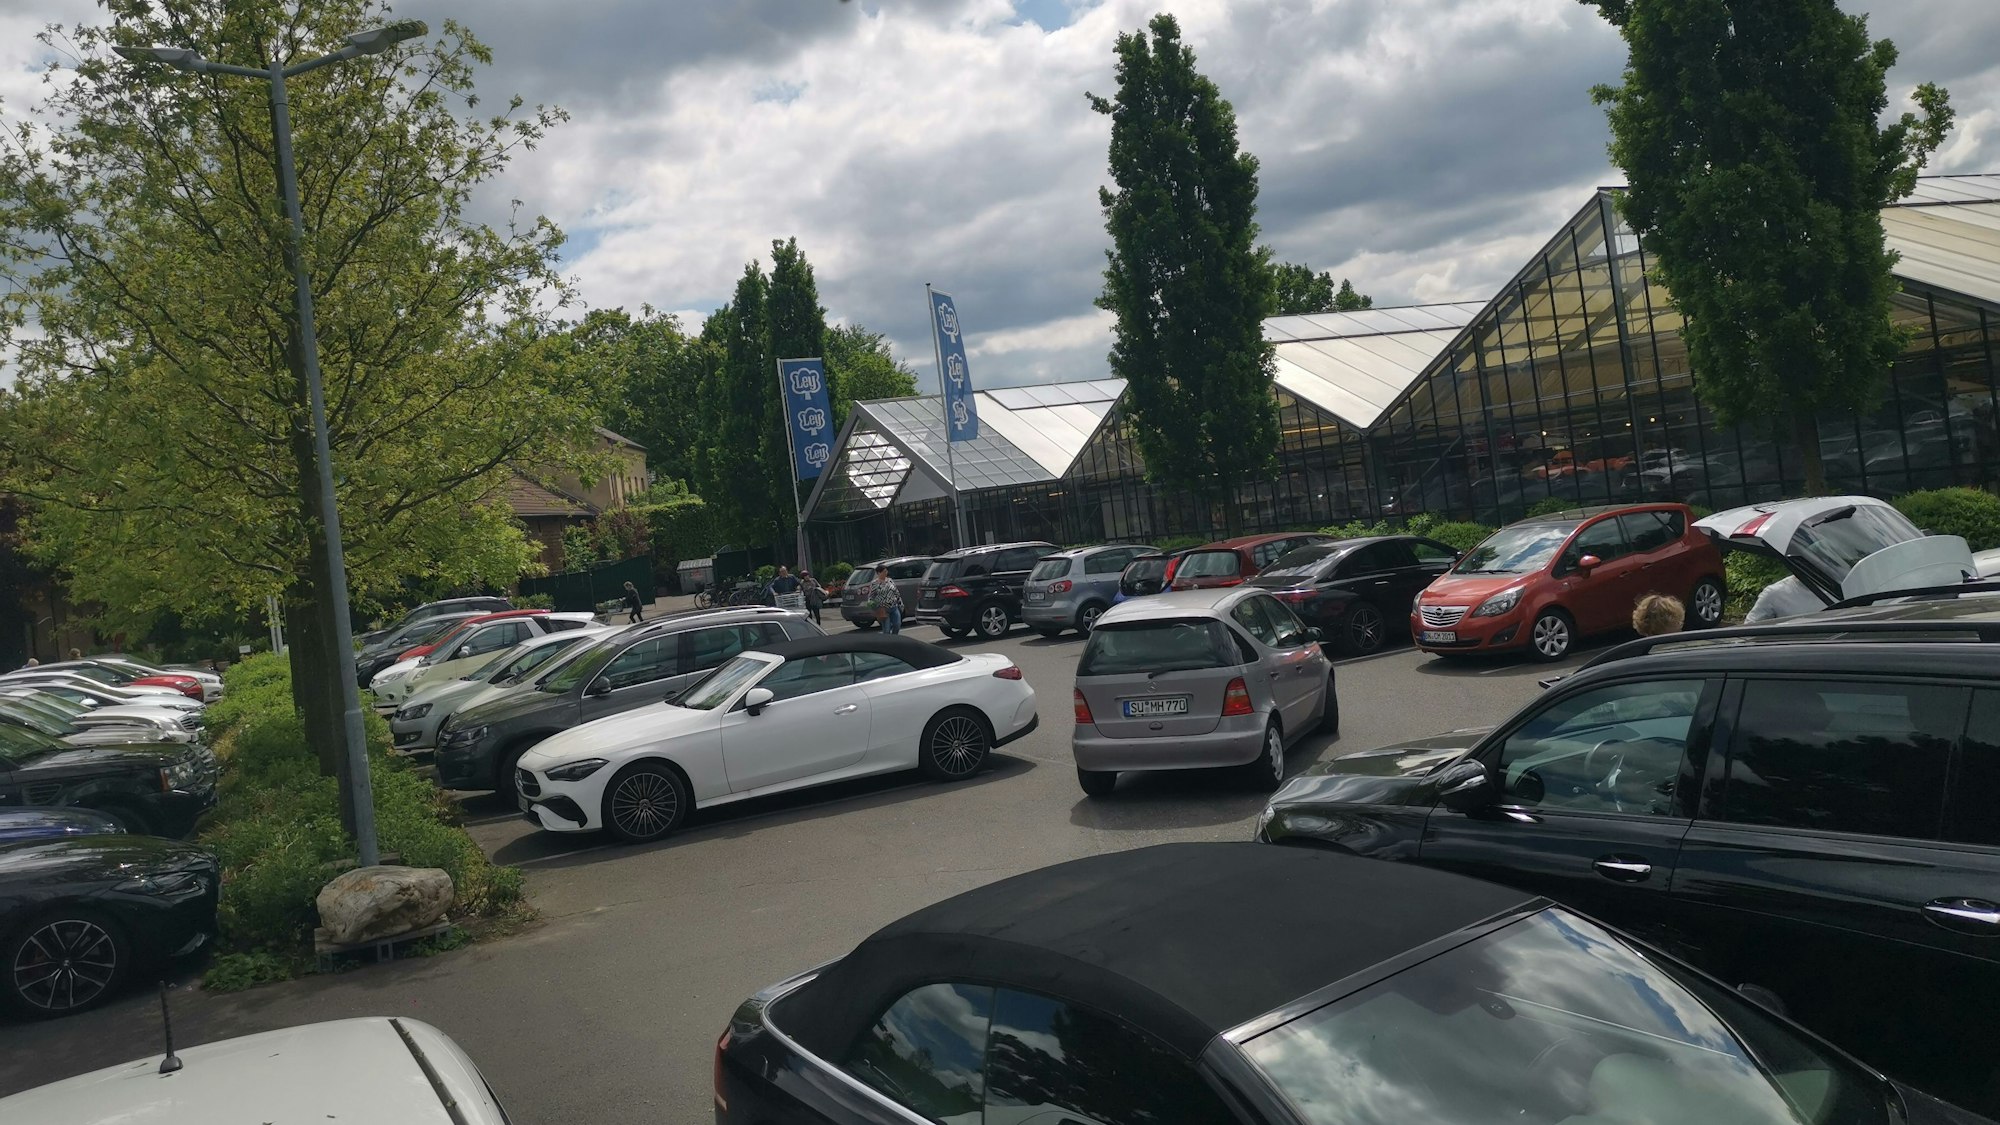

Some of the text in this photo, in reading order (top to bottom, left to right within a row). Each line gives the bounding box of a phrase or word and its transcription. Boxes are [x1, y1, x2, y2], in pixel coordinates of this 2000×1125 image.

[795, 374, 816, 389] Ley
[803, 413, 821, 426] Ley
[809, 447, 825, 460] Ley
[1130, 700, 1186, 713] SU MH 770
